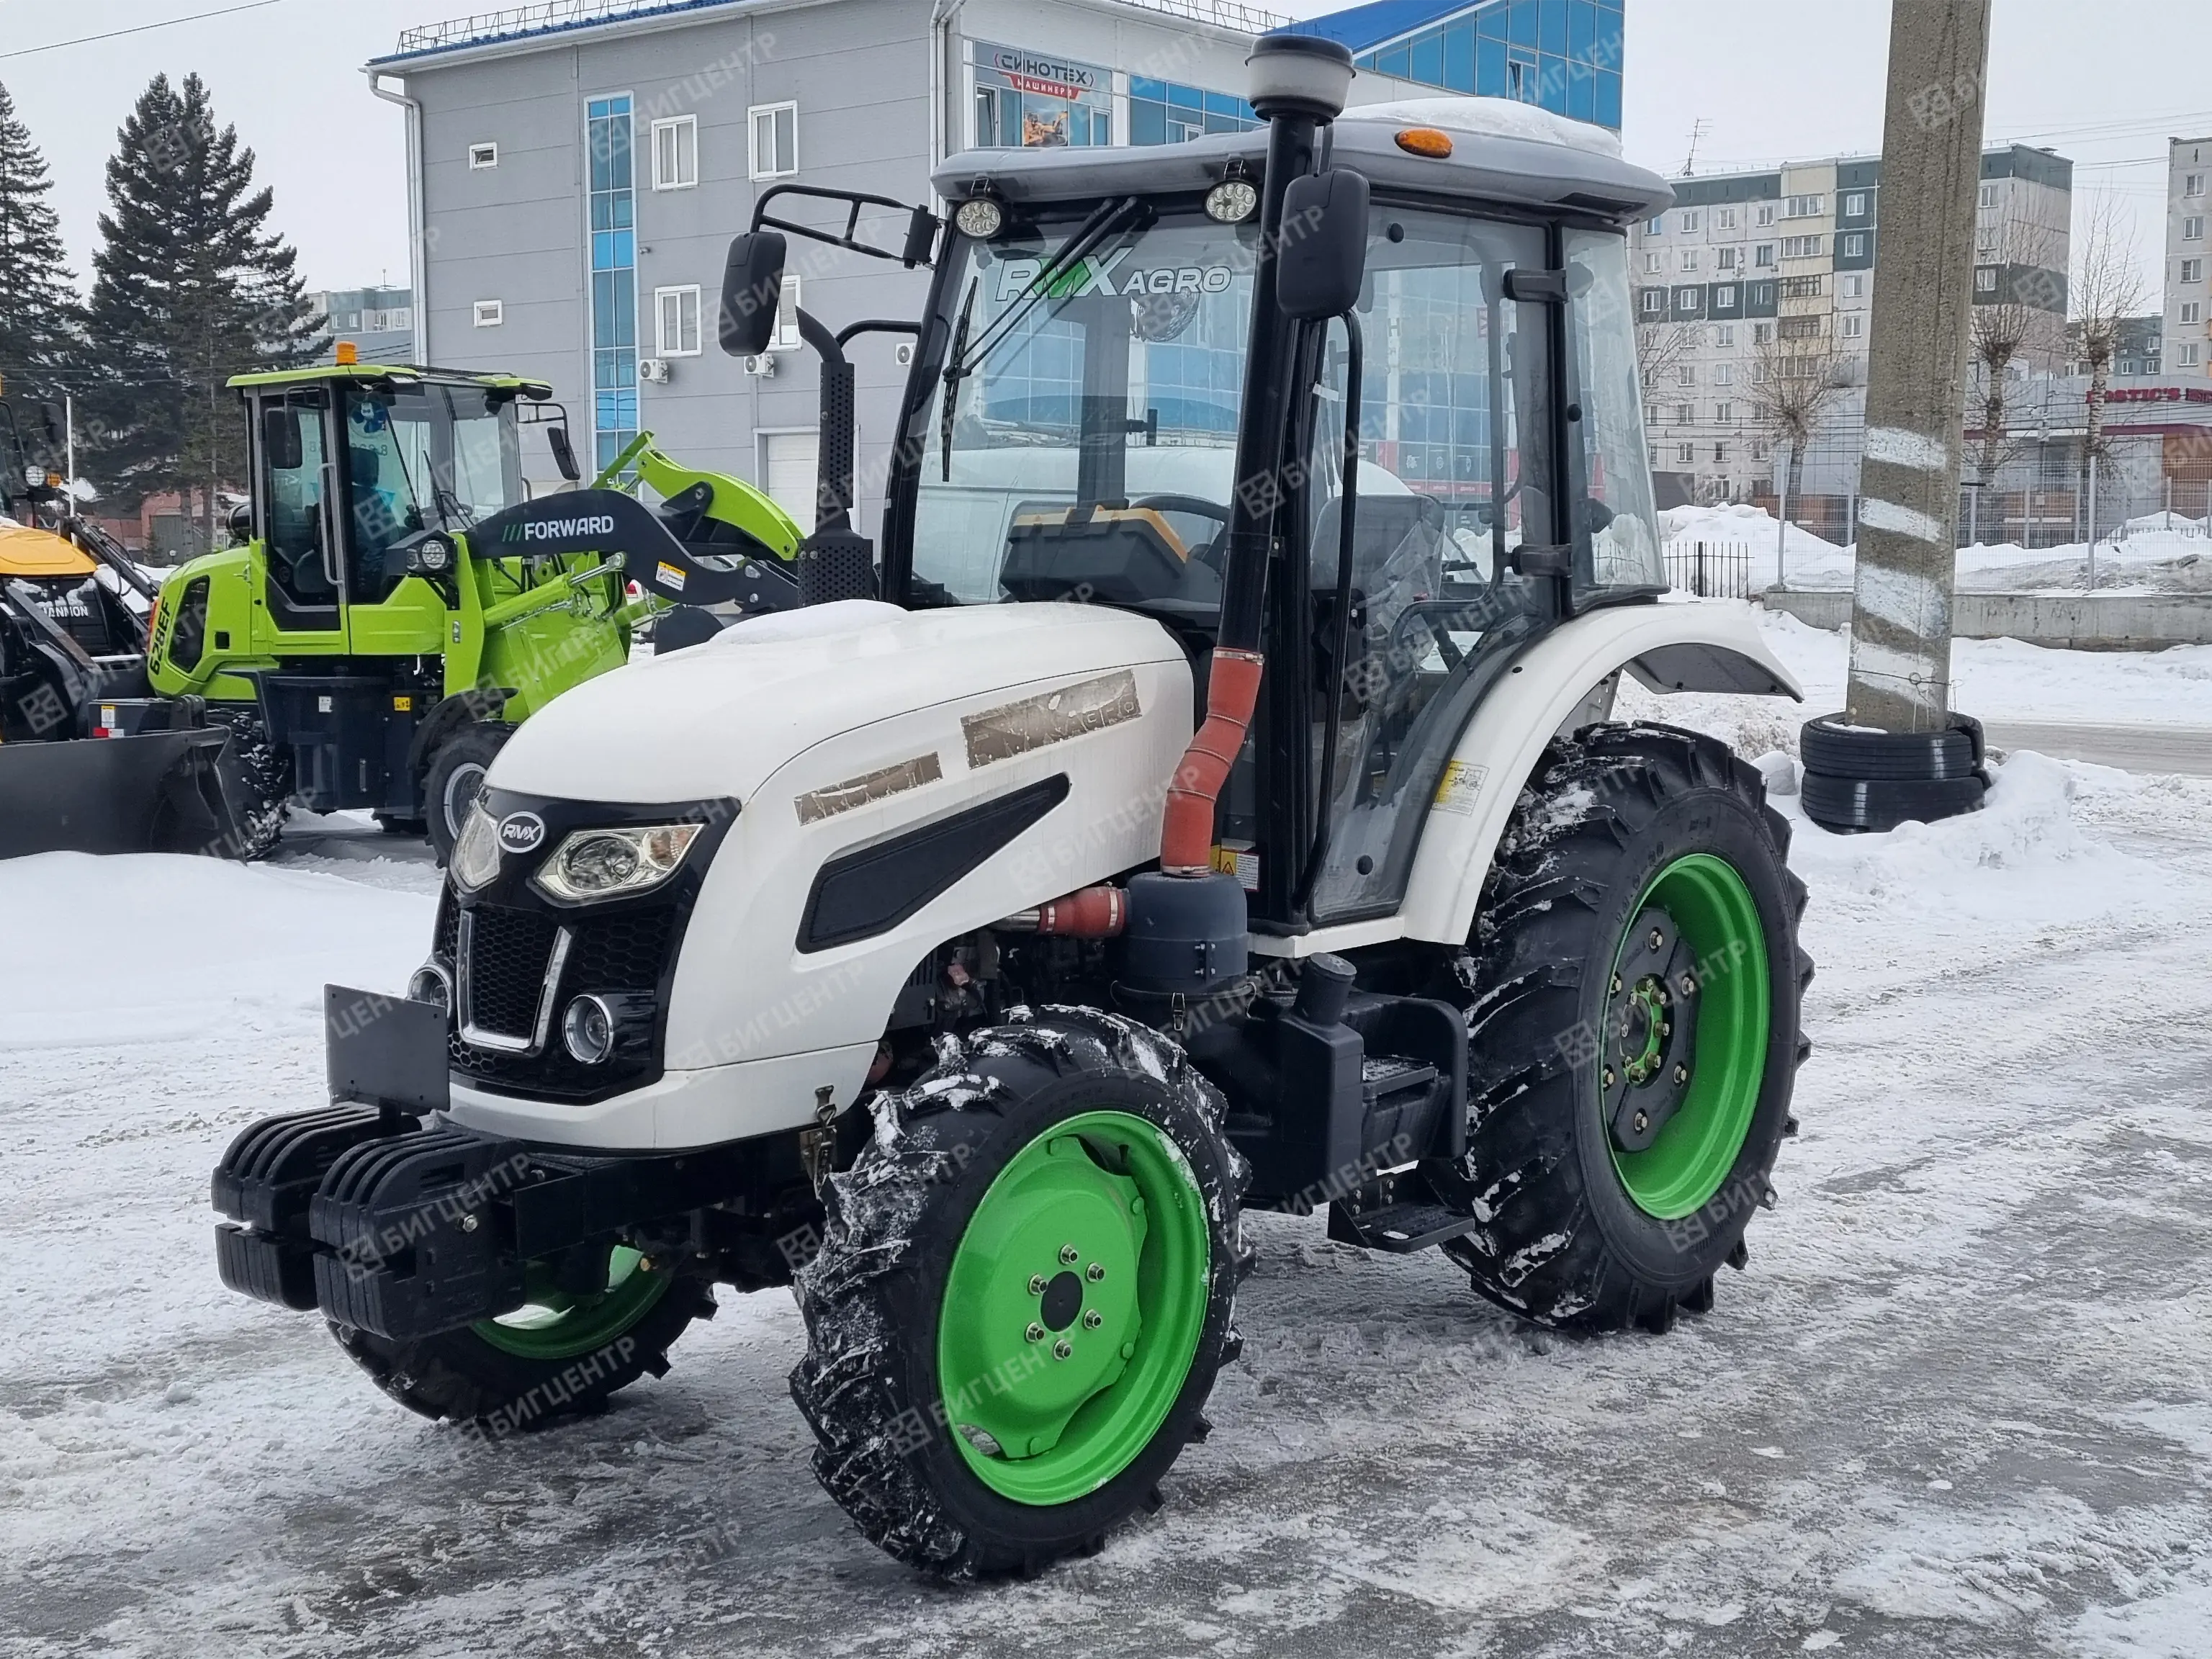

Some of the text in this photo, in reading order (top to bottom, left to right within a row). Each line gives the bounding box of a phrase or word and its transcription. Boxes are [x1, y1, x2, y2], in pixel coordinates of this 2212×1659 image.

[1002, 55, 1087, 84] СИНОТЕХ
[1120, 266, 1232, 295] AGRO
[524, 516, 614, 540] FORWARD
[150, 596, 170, 675] 628EF
[503, 823, 541, 841] RMX
